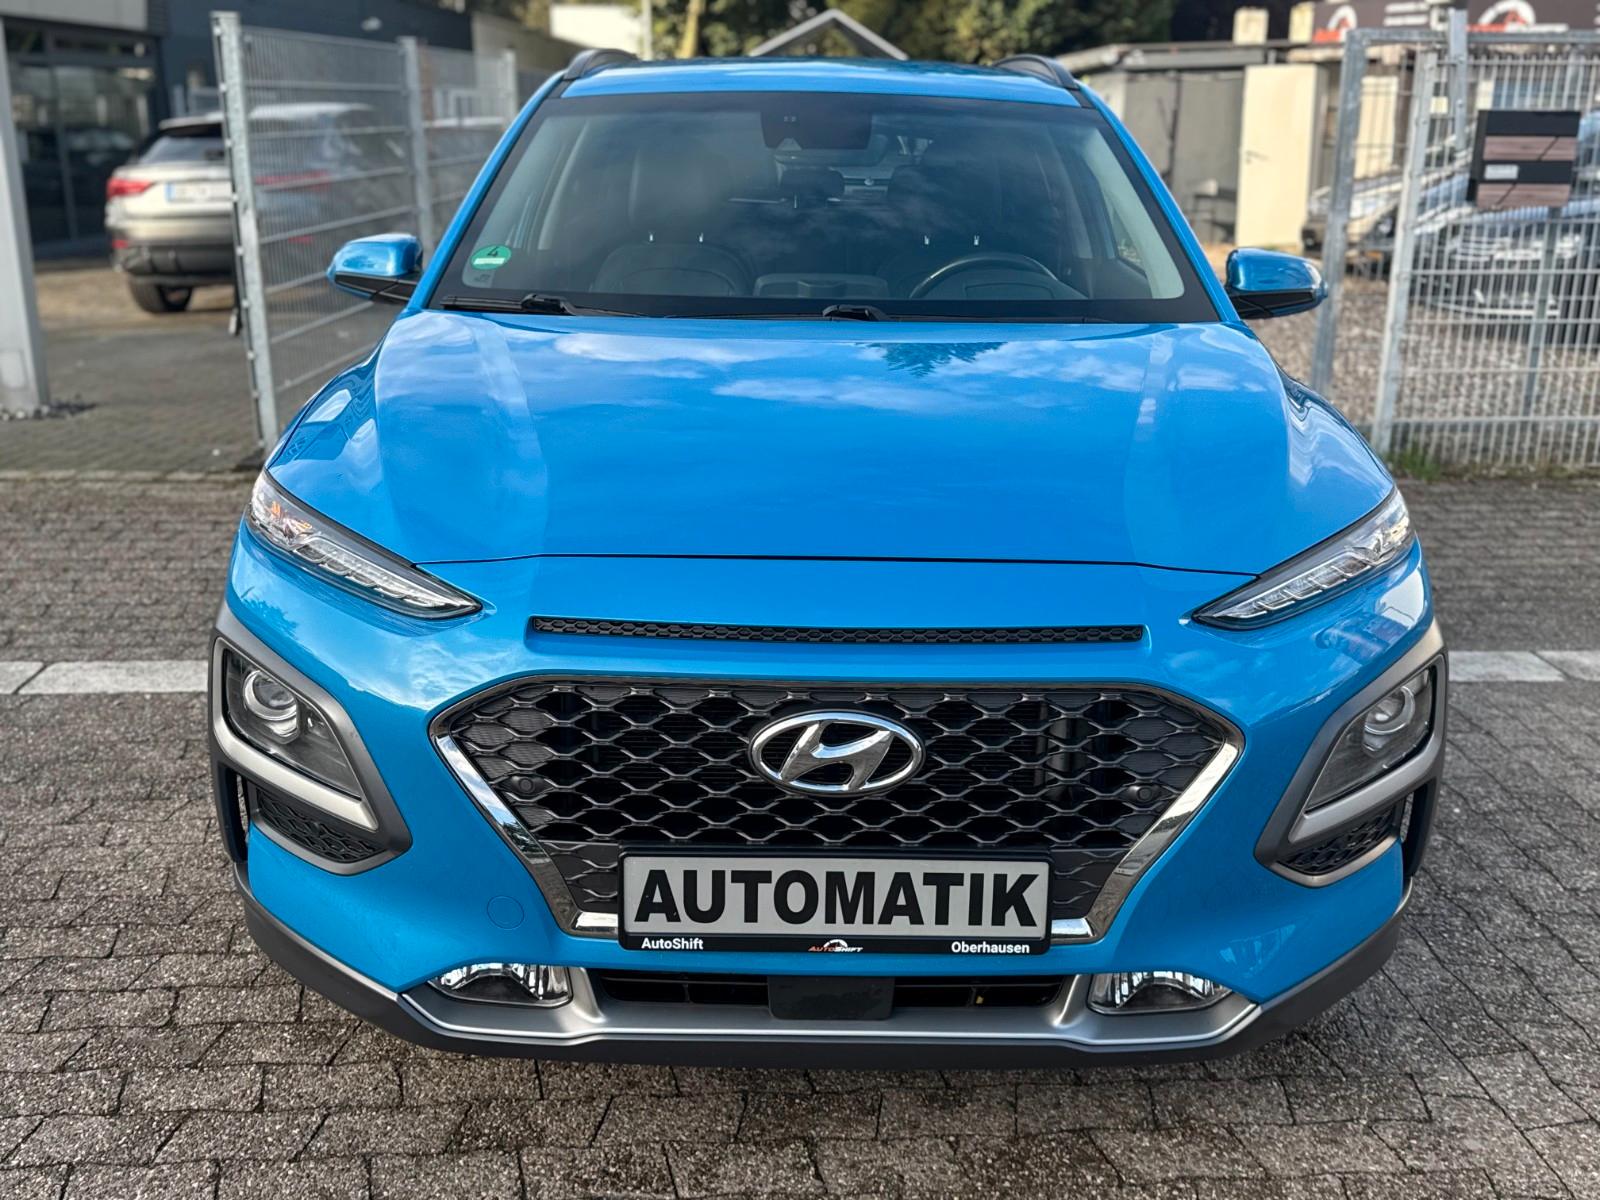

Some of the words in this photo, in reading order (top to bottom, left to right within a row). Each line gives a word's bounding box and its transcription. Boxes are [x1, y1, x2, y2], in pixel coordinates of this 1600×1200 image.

[487, 246, 499, 257] 4
[634, 869, 1040, 928] AUTOMATIK
[641, 937, 704, 950] AutoShift
[951, 940, 1030, 954] Oberhausen
